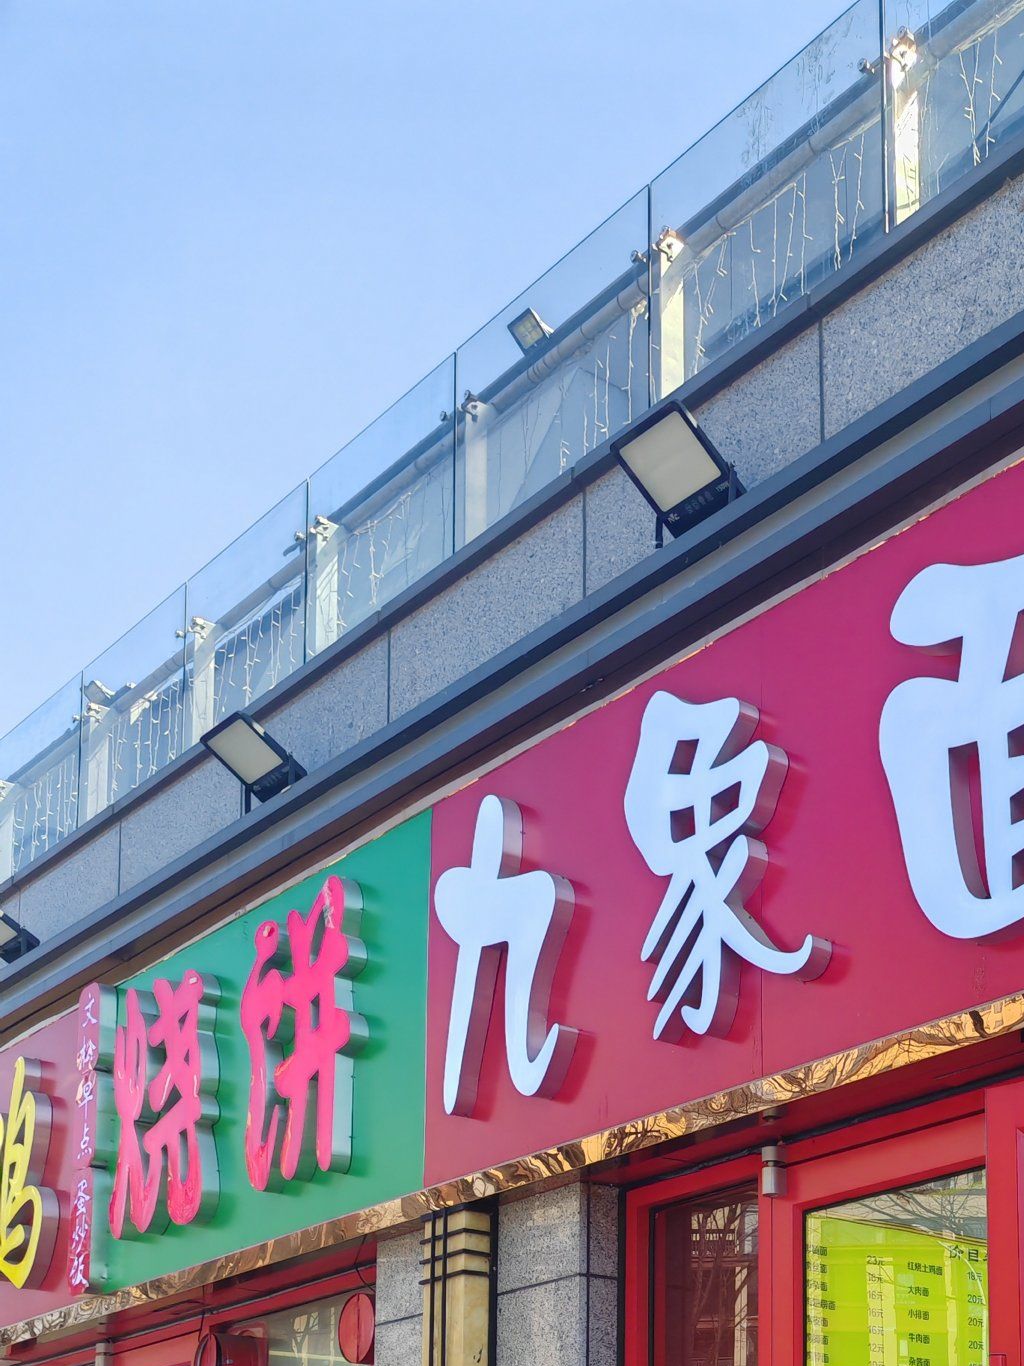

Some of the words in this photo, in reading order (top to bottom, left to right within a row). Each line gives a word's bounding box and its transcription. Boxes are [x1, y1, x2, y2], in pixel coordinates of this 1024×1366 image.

[109, 874, 352, 1239] 烧饼
[949, 1244, 988, 1263] 价目
[967, 1318, 984, 1328] 20元
[968, 1340, 984, 1351] 20元
